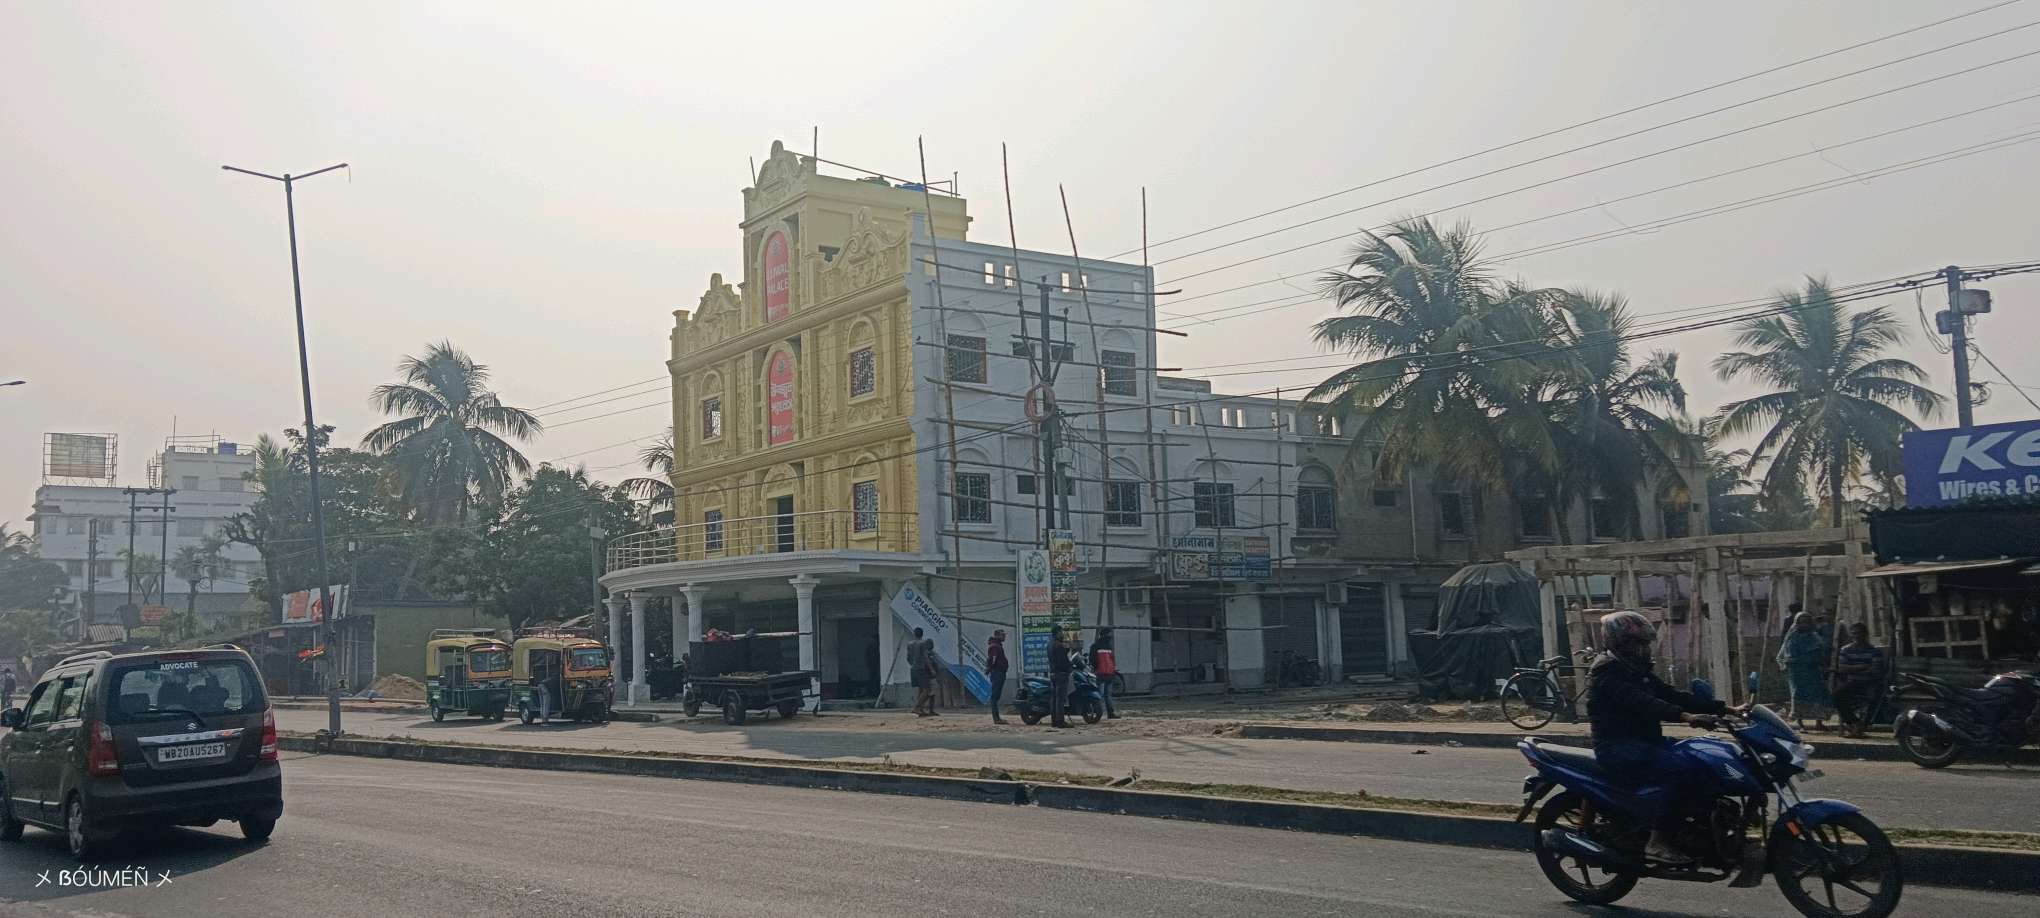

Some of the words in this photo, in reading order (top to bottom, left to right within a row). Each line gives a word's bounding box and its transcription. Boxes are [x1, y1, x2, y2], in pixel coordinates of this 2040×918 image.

[1939, 480, 2001, 500] Wires
[2006, 479, 2021, 495] &
[2025, 475, 2040, 495] C
[160, 661, 199, 671] ADVOCATE
